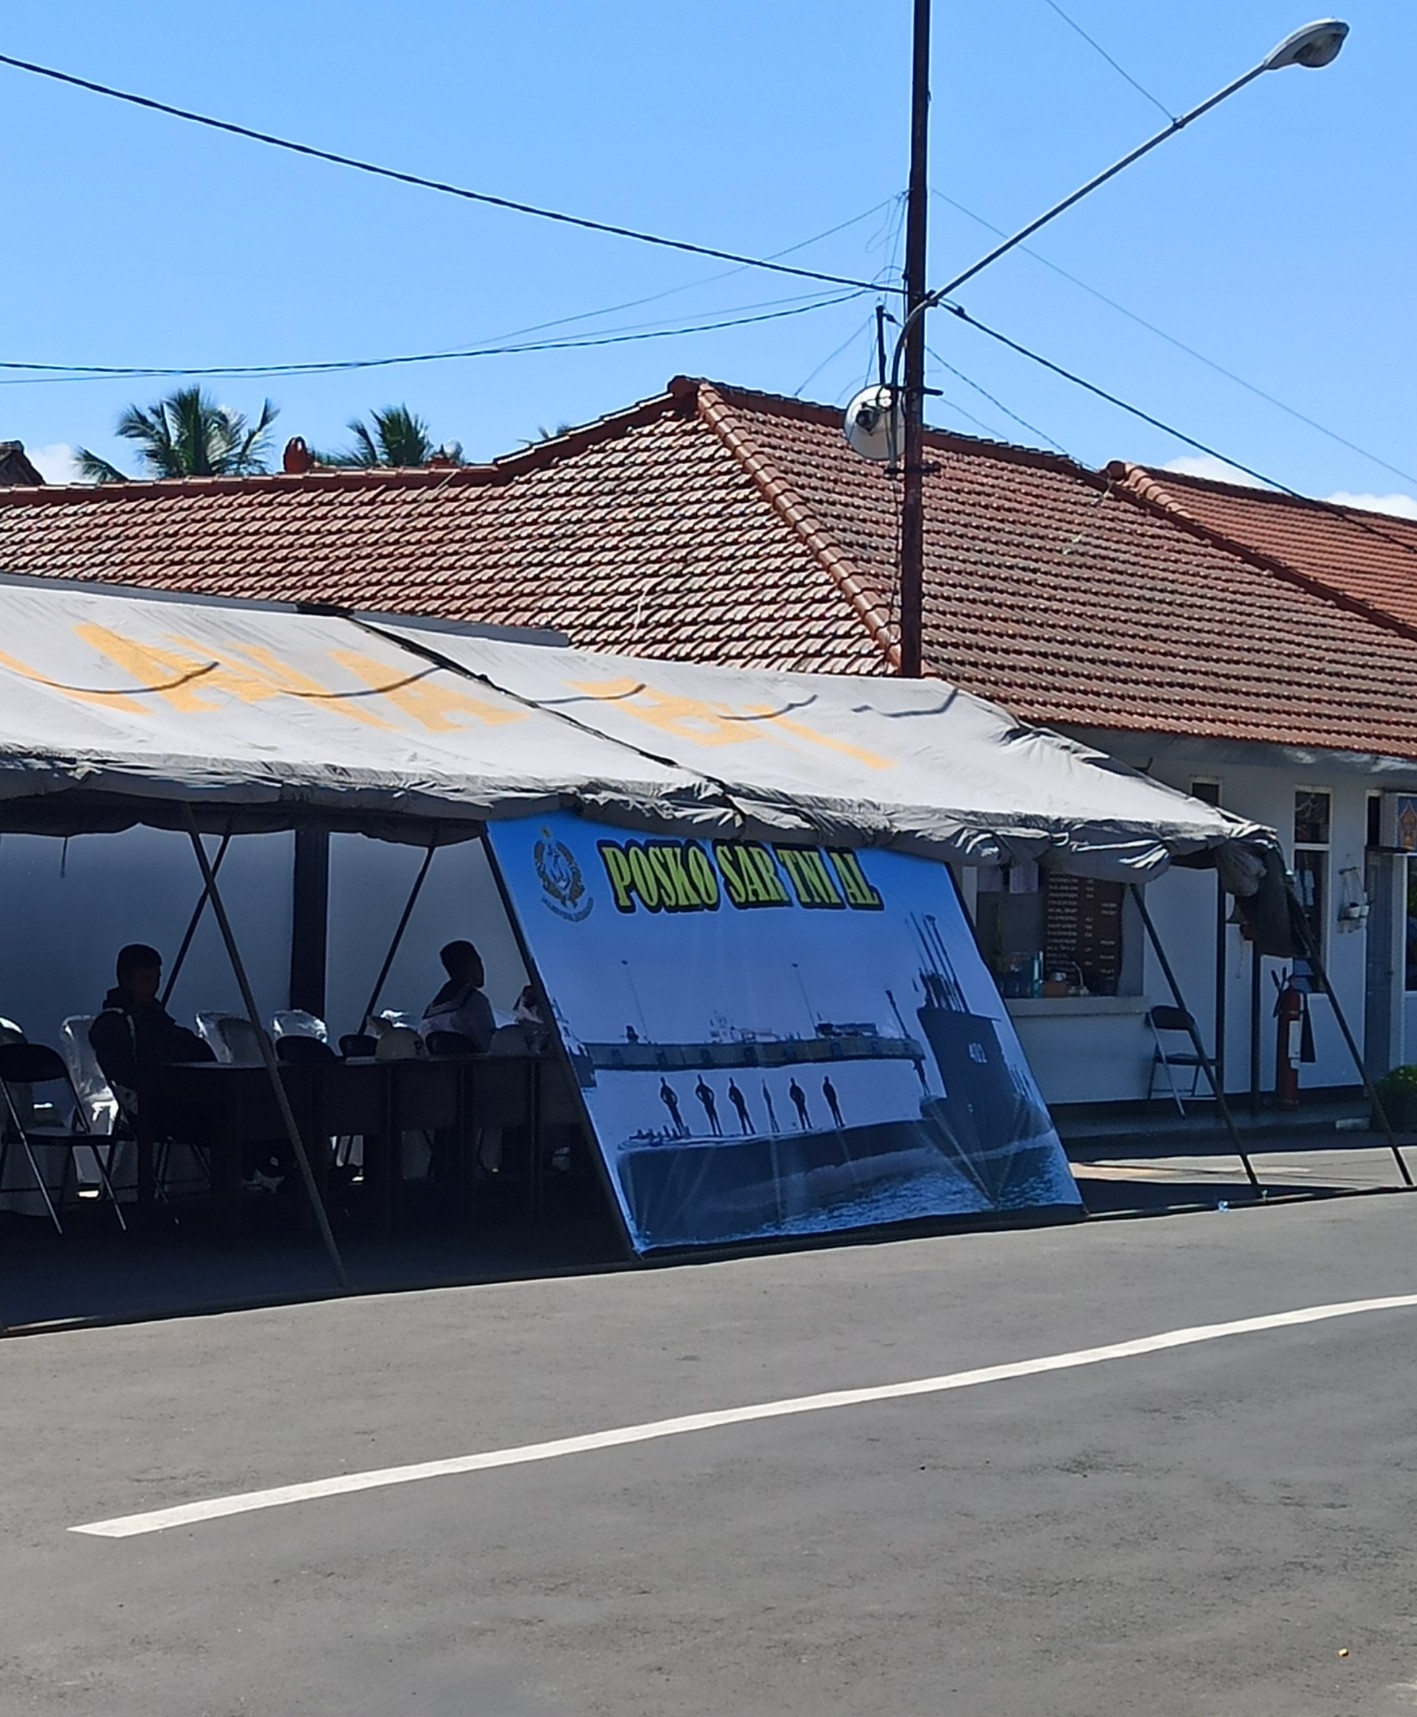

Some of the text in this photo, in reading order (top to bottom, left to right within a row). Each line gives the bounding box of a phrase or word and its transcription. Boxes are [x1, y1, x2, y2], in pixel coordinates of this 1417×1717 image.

[598, 843, 881, 909] POSKO SAR TNI AL
